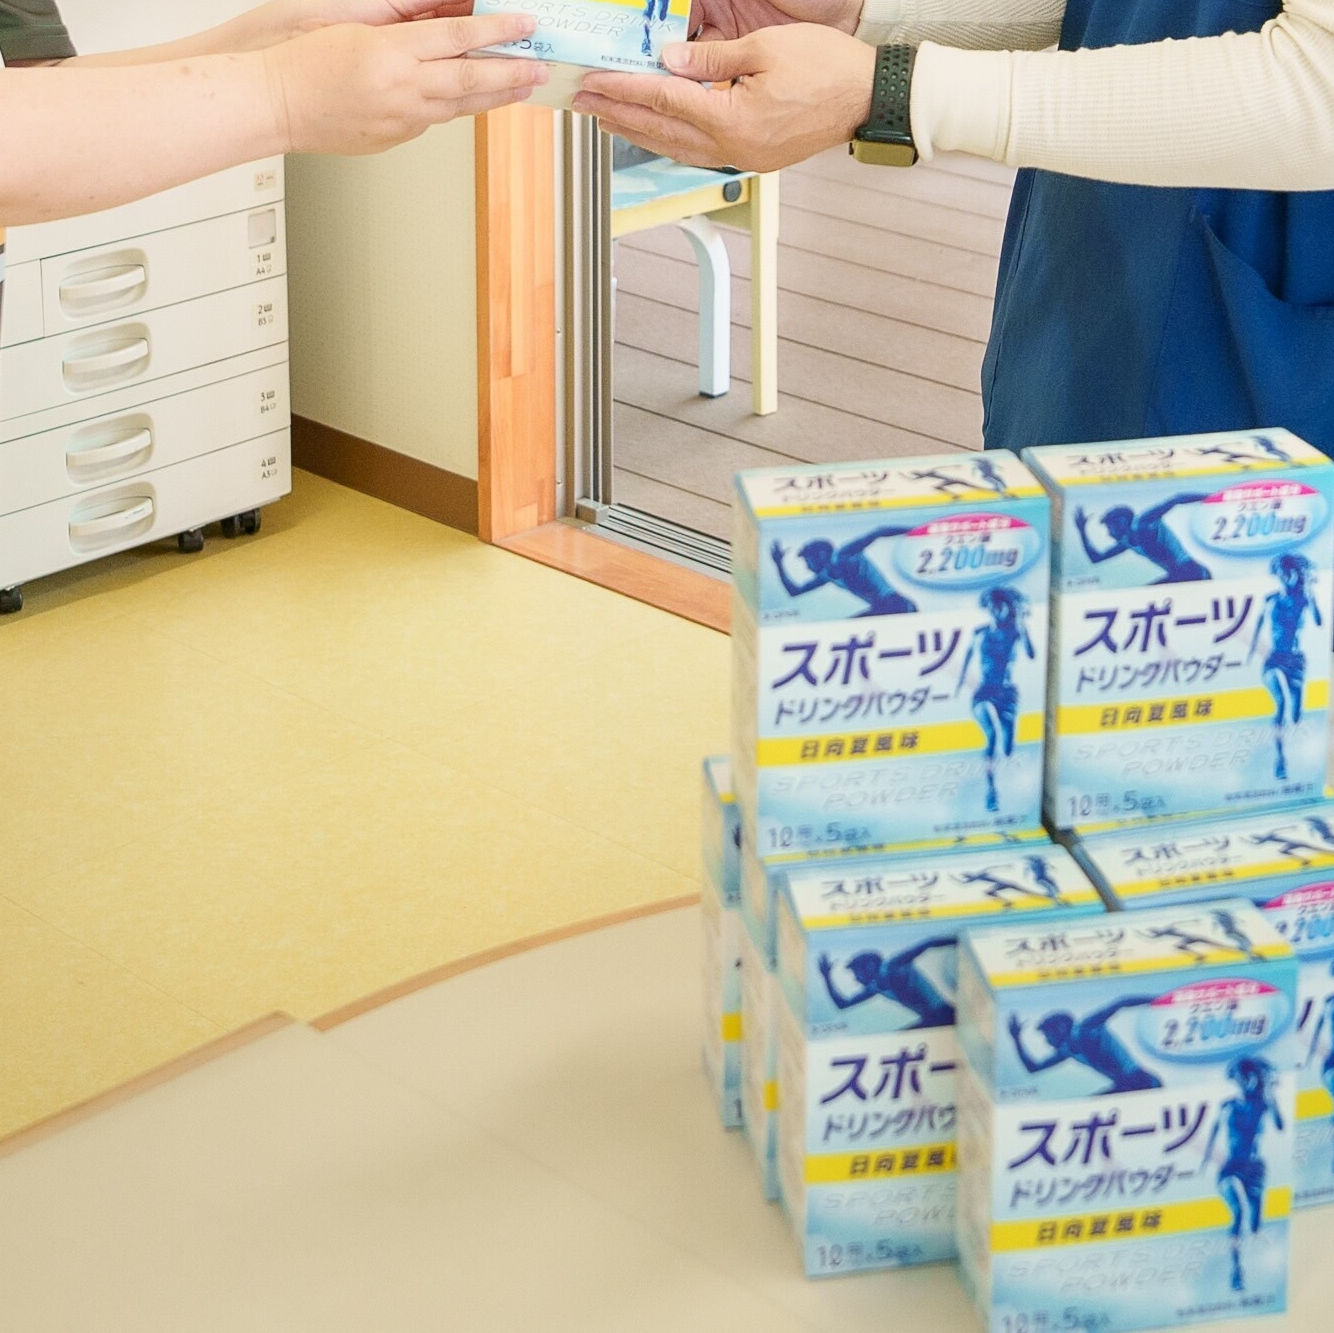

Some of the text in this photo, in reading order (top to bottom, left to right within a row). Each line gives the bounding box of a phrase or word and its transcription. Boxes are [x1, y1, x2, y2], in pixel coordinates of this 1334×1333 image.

[529, 15, 626, 37] OWDER
[598, 9, 678, 33] DRINK
[1069, 446, 1174, 468] スポーツ
[773, 469, 890, 493] スポーツ
[1211, 511, 1308, 542] 2,200mg
[916, 546, 1019, 576] 2,200mg
[1073, 595, 1254, 657] スポーツ
[772, 626, 962, 690] スポーツ
[1075, 651, 1243, 694] ドリンクパウダー
[774, 685, 951, 728] ドリンクパウダー
[1100, 699, 1214, 728] 日向夏風味
[800, 731, 921, 760] 日向夏風味
[1121, 835, 1233, 864] スポーツ
[821, 873, 939, 897] スポーツ
[1004, 929, 1126, 955] スポーツ
[1161, 1014, 1265, 1048] 2,200mg
[1008, 1101, 1208, 1169] スポーツ
[848, 1147, 956, 1177] 日向夏風
[1009, 1167, 1195, 1209] ドリンクパウダー
[1036, 1209, 1164, 1244] 日向夏風味
